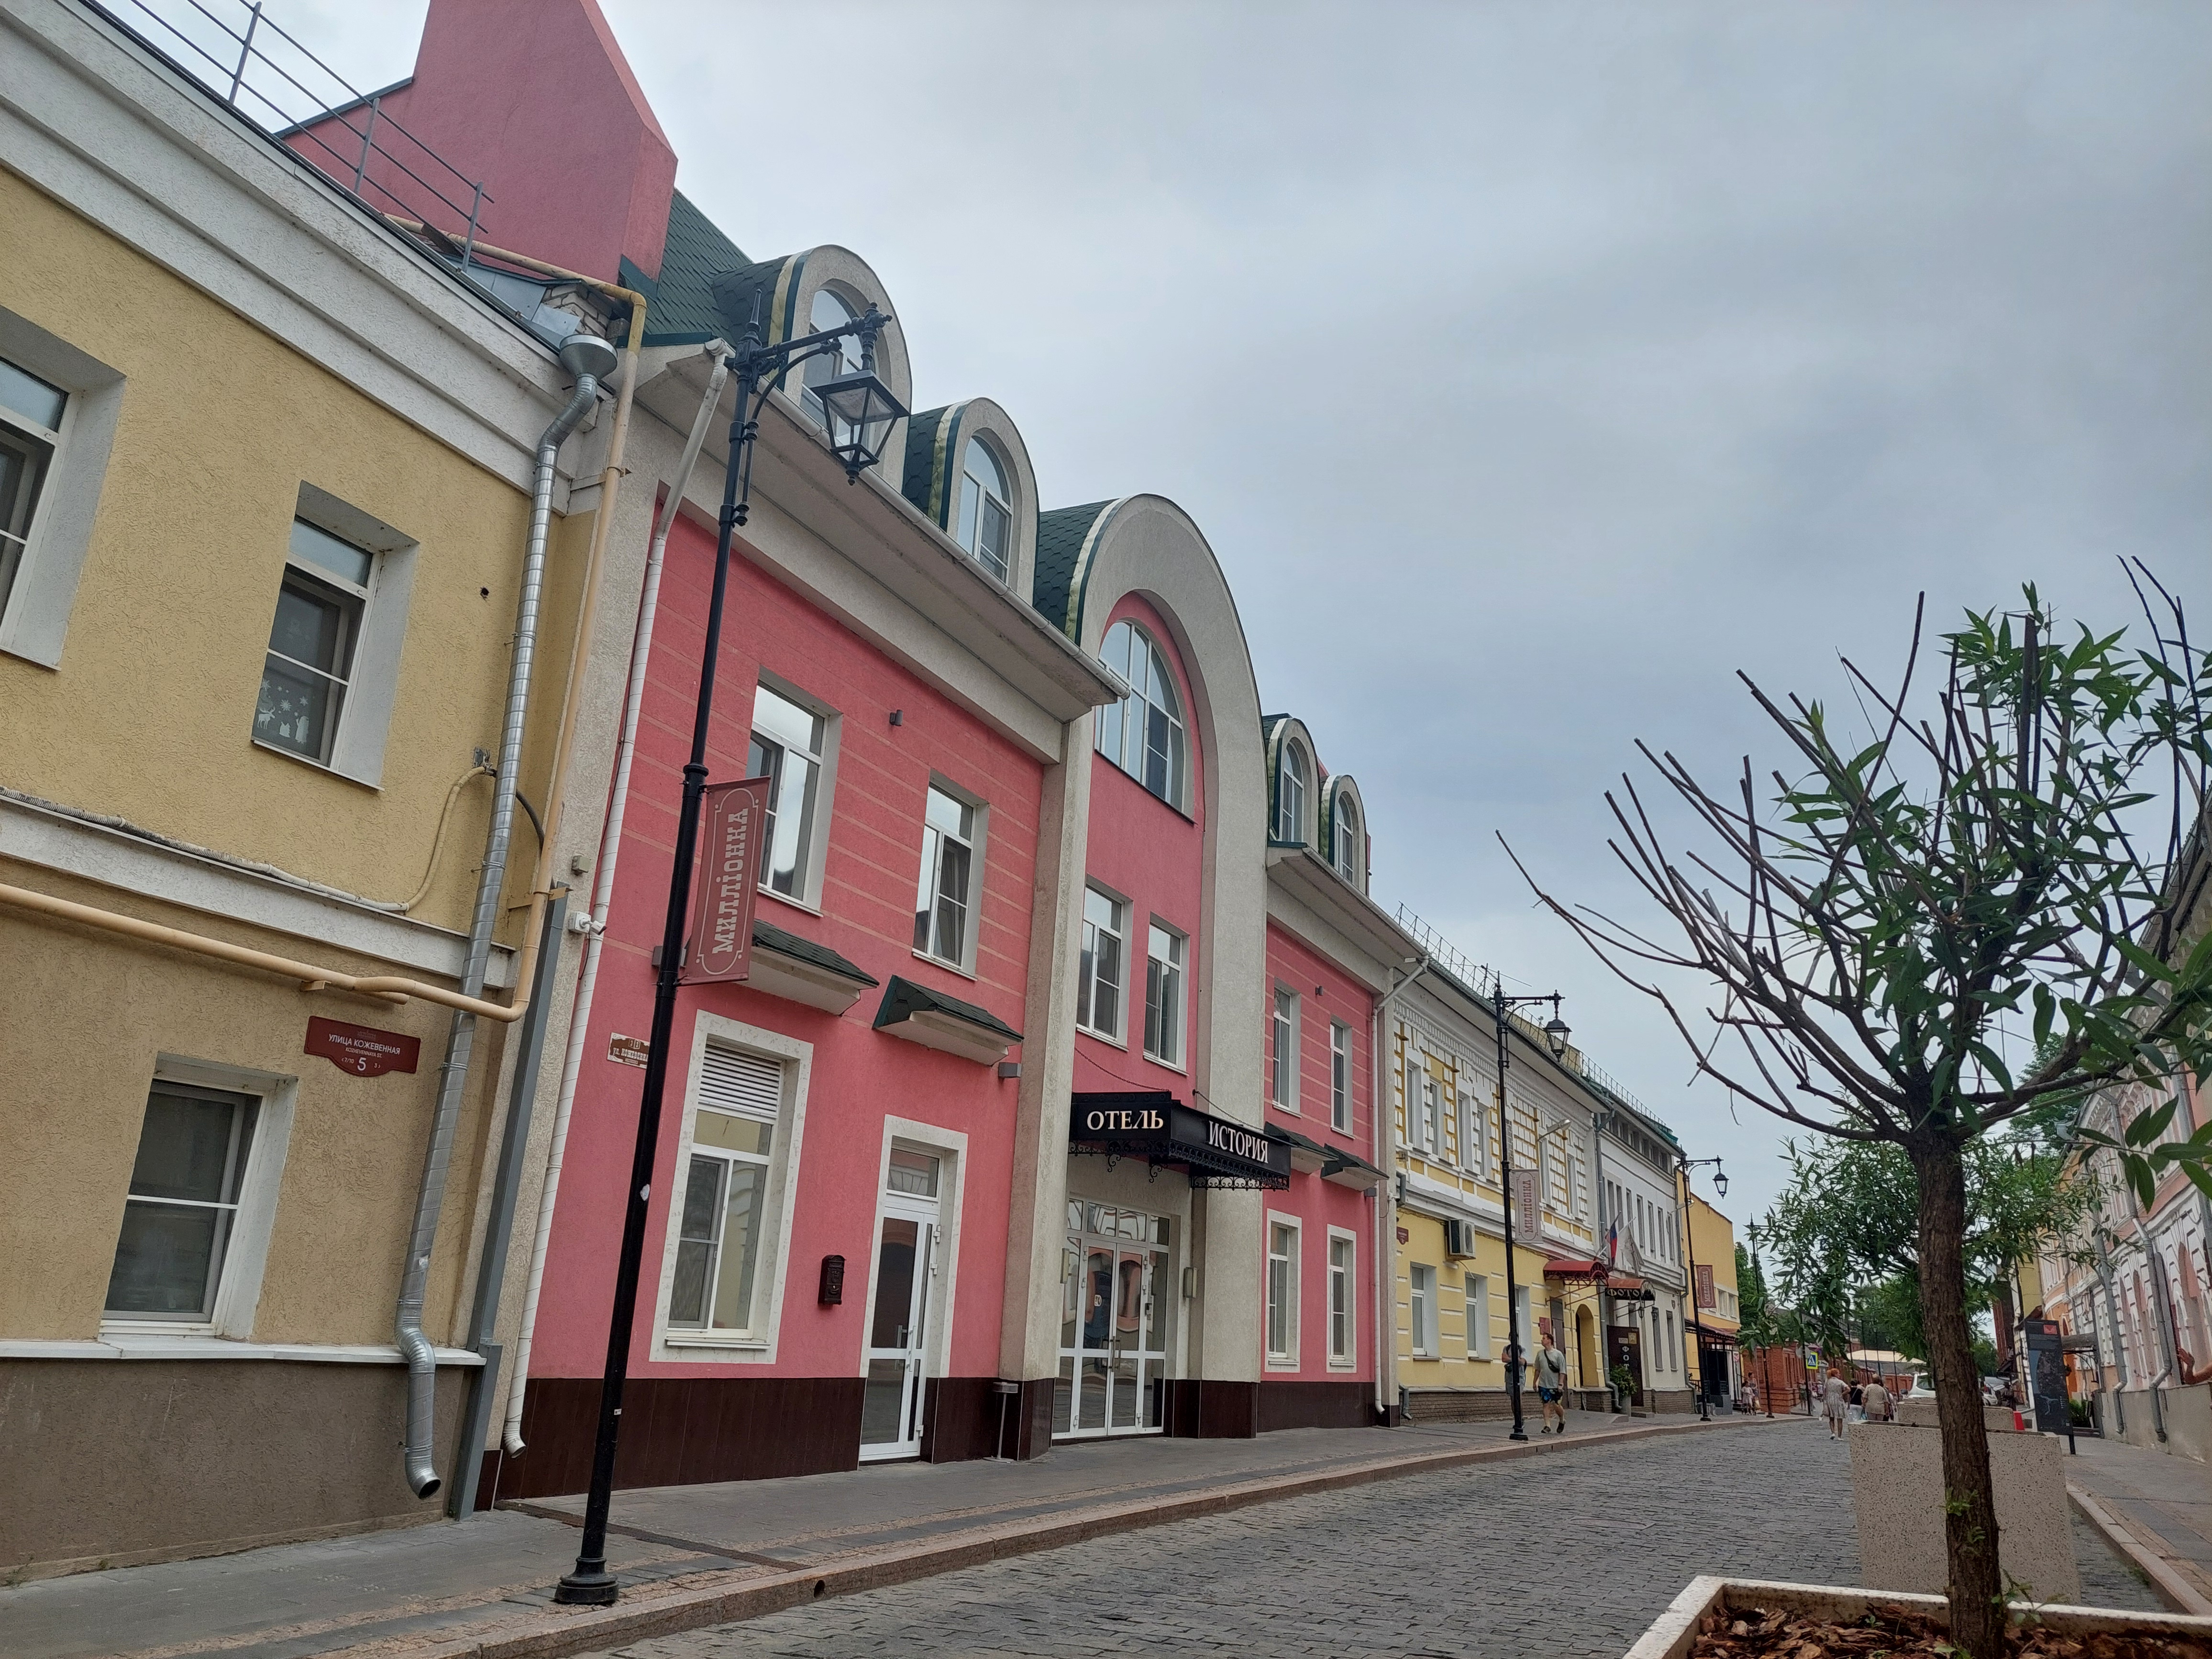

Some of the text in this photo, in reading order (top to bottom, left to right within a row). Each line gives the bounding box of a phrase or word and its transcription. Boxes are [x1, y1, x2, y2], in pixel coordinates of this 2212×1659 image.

[329, 1033, 400, 1055] УЛИЦА КОЖЕВЕННАЯ
[345, 1047, 376, 1057] KOZHEVENNAYA
[357, 1057, 366, 1071] 5
[1086, 1110, 1164, 1130] ОТЕЛЬ
[1208, 1120, 1269, 1164] ИСТОРИЯ
[1607, 1288, 1640, 1297] ФОТО
